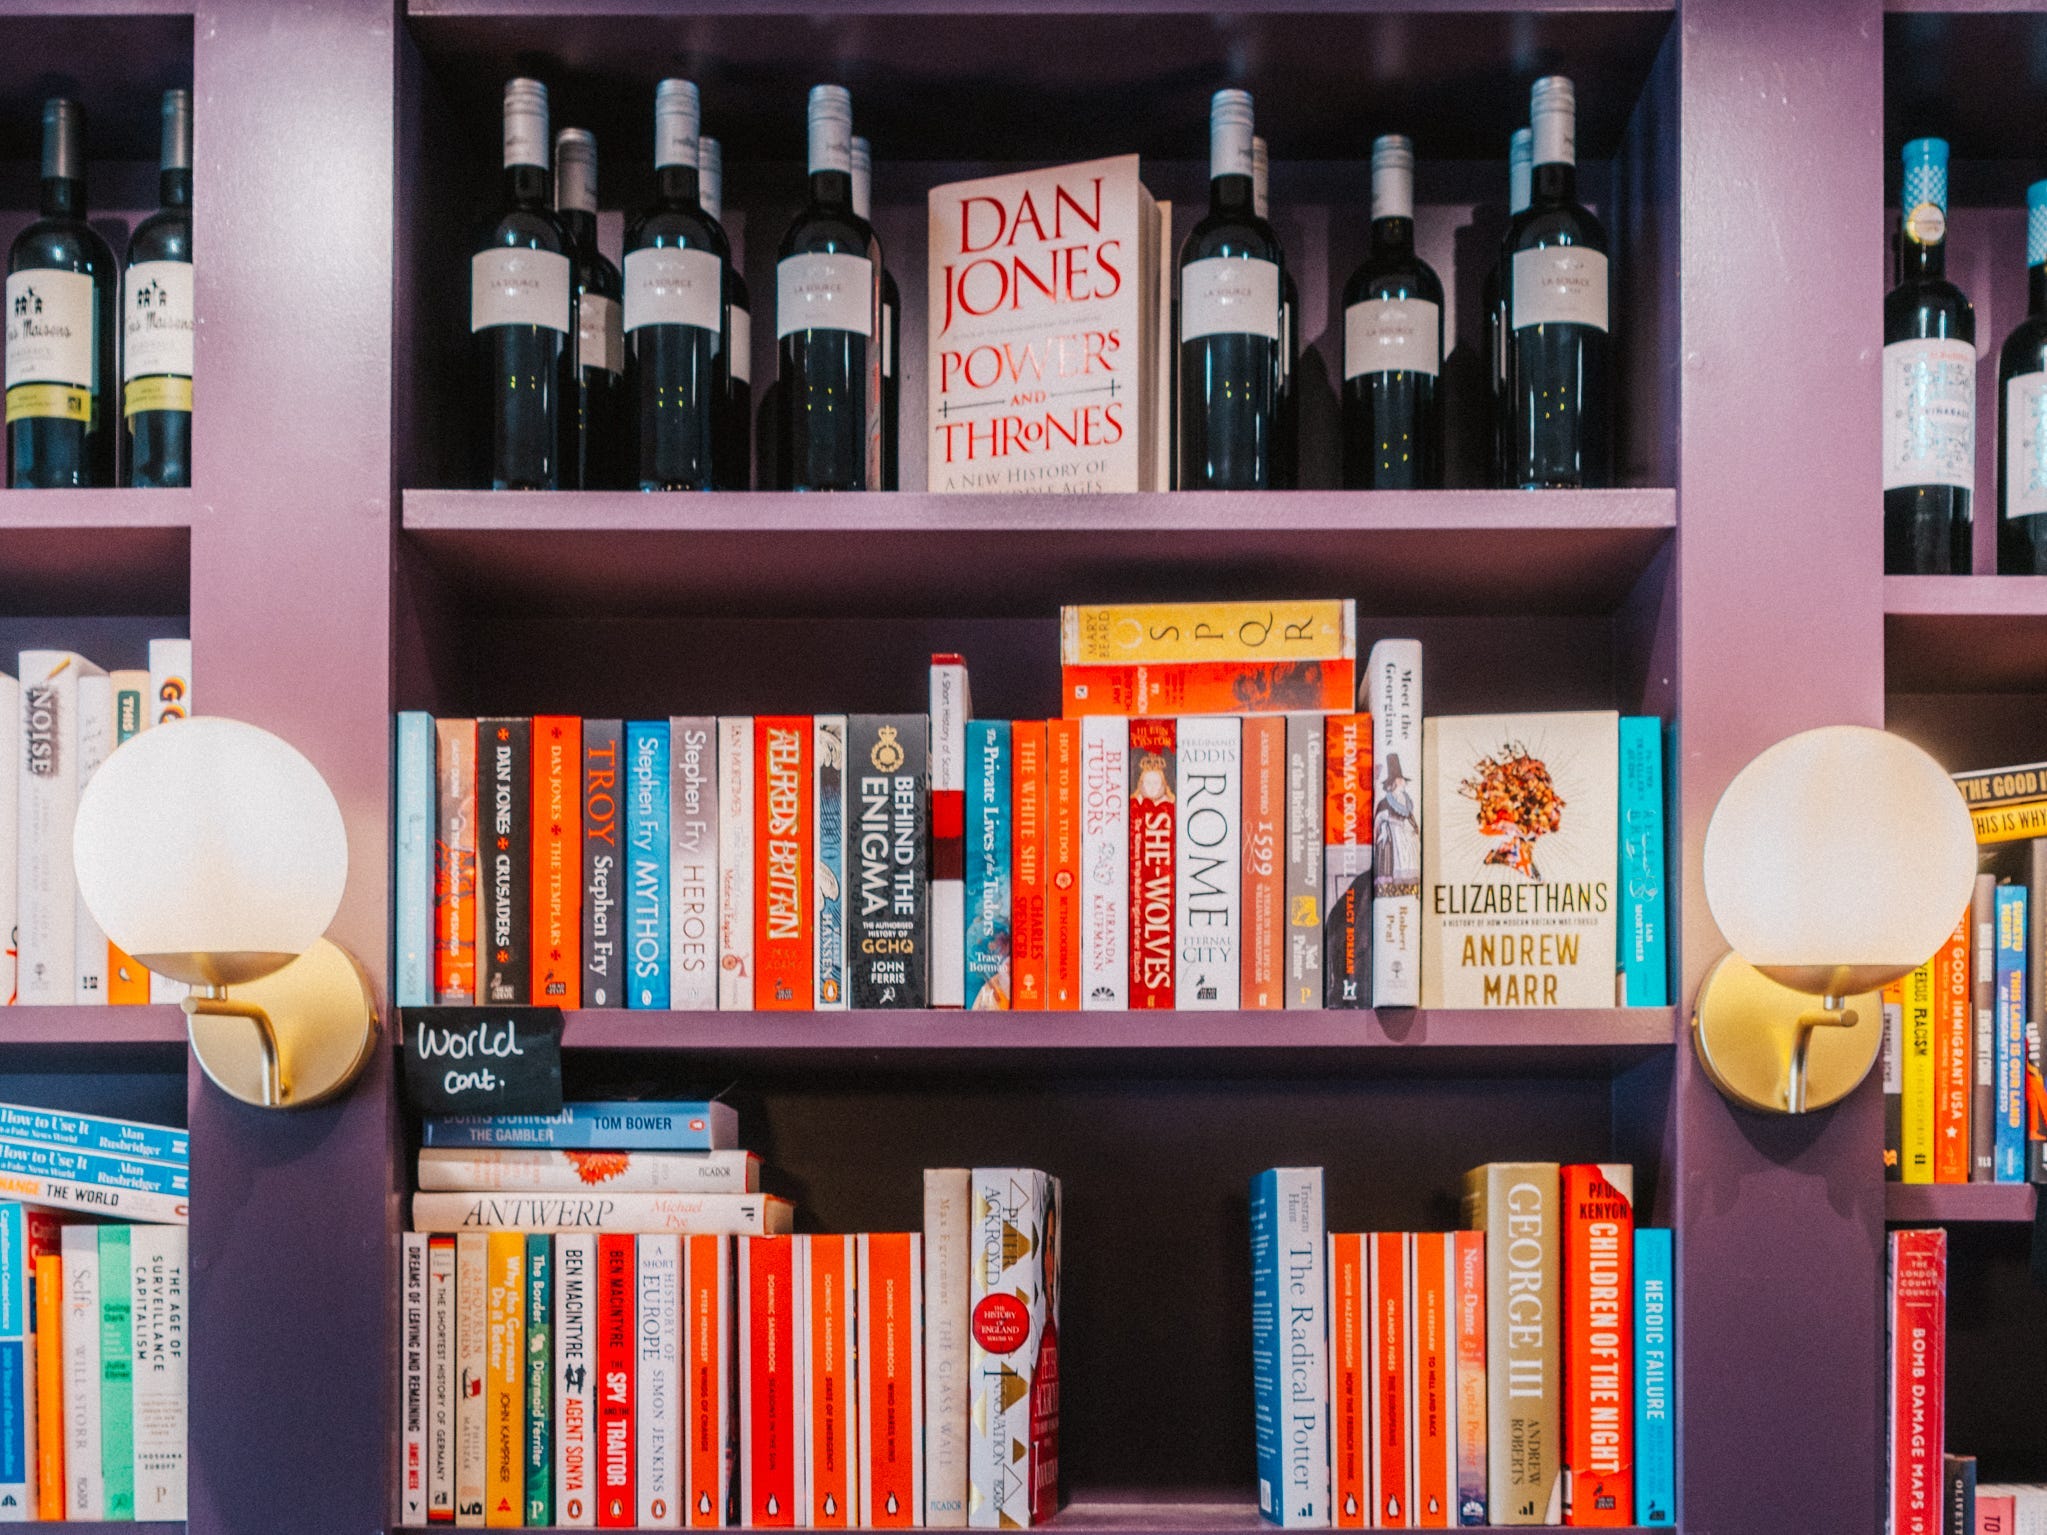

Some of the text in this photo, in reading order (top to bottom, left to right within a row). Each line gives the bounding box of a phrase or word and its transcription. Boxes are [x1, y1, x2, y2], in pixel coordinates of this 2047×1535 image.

[960, 177, 1104, 254] DAN
[937, 240, 1121, 339] JONES
[940, 329, 1121, 394] POWERS
[1010, 391, 1047, 407] AND
[935, 402, 1123, 465] THRONES
[946, 460, 1107, 491] A NEW HISTORY OF
[28, 688, 54, 775] NOISE
[122, 696, 135, 732] THIS
[1383, 663, 1397, 746] Georgians
[1401, 670, 1412, 740] Meet the
[496, 746, 510, 834] DAN JONES
[550, 745, 561, 820] DAN JONES
[633, 737, 658, 849] Stephen Fry
[679, 730, 707, 853] Stephen Fry
[1087, 738, 1104, 835] TUDORS
[1105, 751, 1121, 825] BLACK
[1182, 750, 1235, 762] ADDIS
[1956, 772, 2037, 801] THE GOOD
[587, 740, 615, 848] TROY
[1020, 740, 1036, 886] THE WHITE SHIP
[1343, 723, 1357, 878] THOMAS CROMWELL
[861, 777, 889, 916] ENIGMA
[894, 776, 914, 915] BEHIND THE
[1187, 773, 1229, 928] ROME
[1253, 821, 1273, 876] 1599
[496, 854, 510, 946] CRUSADERS
[550, 841, 562, 945] THE TEMPLARS
[590, 855, 613, 976] Stephen Fry
[635, 860, 659, 978] MYTHOS
[683, 865, 704, 972] HEROES
[1144, 812, 1171, 989] SHE-WOLVES
[1385, 914, 1395, 943] Peal
[1399, 906, 1409, 951] Robert
[1434, 883, 1608, 915] ELIZABETHANS
[2001, 904, 2011, 948] MEHTA
[822, 913, 834, 979] HANSEN
[862, 939, 914, 954] GCHQ
[871, 961, 905, 973] JOHN
[1183, 946, 1231, 963] CITY
[1345, 888, 1355, 974] TRACY BORMAN
[1462, 934, 1580, 967] ANDREW
[1635, 904, 1643, 962] MORTIMER
[871, 972, 906, 984] FERRIS
[1483, 974, 1558, 1006] MARR
[418, 1020, 524, 1059] World
[2010, 969, 2022, 1127] THIS LAND IS OUR LAND
[0, 1109, 89, 1135] How to Use It
[99, 1137, 161, 1157] Rusbridger
[120, 1126, 145, 1141] Alan
[469, 1129, 554, 1142] THE GAMBLER
[593, 1117, 672, 1131] TOM BOWER
[650, 1201, 702, 1214] Michael
[698, 1167, 732, 1178] PICADOR
[1288, 1193, 1299, 1222] Hunt
[1301, 1183, 1312, 1232] Tristram
[462, 1200, 616, 1227] ANTWERP
[984, 1186, 1001, 1286] ACKROYD
[1002, 1207, 1019, 1268] PETER
[1580, 1203, 1628, 1220] KENYON
[532, 1255, 544, 1322] The Border
[938, 1199, 951, 1304] Max Egremont
[72, 1268, 90, 1318] Selfie
[136, 1266, 147, 1361] CAPITALISM
[152, 1255, 164, 1372] SURVEILLANCE
[169, 1268, 180, 1358] THE AGE OF
[504, 1256, 520, 1383] Why the Germans
[565, 1249, 582, 1358] BEN MACINTYRE
[610, 1250, 623, 1348] BEN MACINTYRE
[643, 1274, 661, 1360] EUROPE
[665, 1273, 675, 1363] HISTORY OF
[1464, 1247, 1479, 1336] Notre-Dame
[1507, 1182, 1543, 1399] GEORGE III
[1645, 1280, 1664, 1343] HEROIC
[408, 1246, 420, 1432] DREAMS OF LEAVING AND REMAINING
[1289, 1242, 1314, 1490] The Radical Potter
[1387, 1299, 1395, 1371] ORLANDO FIGES
[1589, 1222, 1618, 1472] CHILDREN OF THE NIGHT
[75, 1344, 86, 1449] WILL STORR
[436, 1288, 446, 1480] THE SHORTEST HISTORY OF GERMANY
[606, 1372, 627, 1403] SPY
[939, 1320, 952, 1466] THE GLASS WALL
[984, 1367, 1018, 1466] INNOVATION
[1645, 1350, 1664, 1419] FAILURE
[500, 1391, 510, 1483] JOHN KAMPFNER
[566, 1398, 583, 1490] AGENT SONYA
[606, 1419, 627, 1486] TRAITOR
[653, 1369, 664, 1492] SIMON JENKINS
[1511, 1418, 1524, 1486] ROBERTS
[1528, 1418, 1541, 1486] ANDREW
[1911, 1328, 1925, 1535] BOMB DAMAGE MAPS 19
[1984, 1516, 2001, 1533] TO
